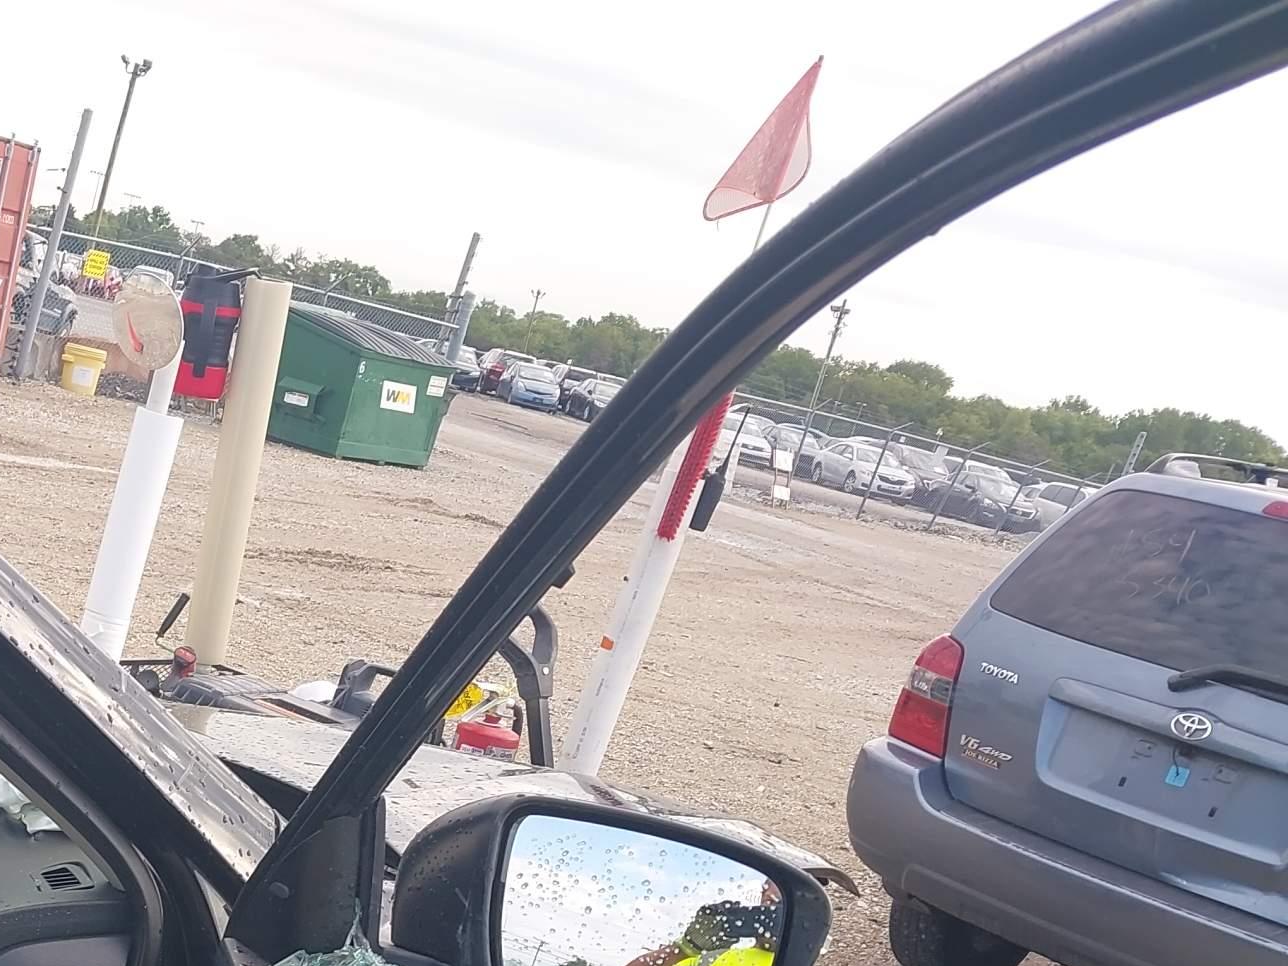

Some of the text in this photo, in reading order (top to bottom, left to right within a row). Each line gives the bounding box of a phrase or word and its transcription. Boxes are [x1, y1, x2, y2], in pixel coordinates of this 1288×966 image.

[386, 388, 411, 405] WM
[979, 662, 1019, 684] TOYOTA
[959, 734, 981, 750] V6
